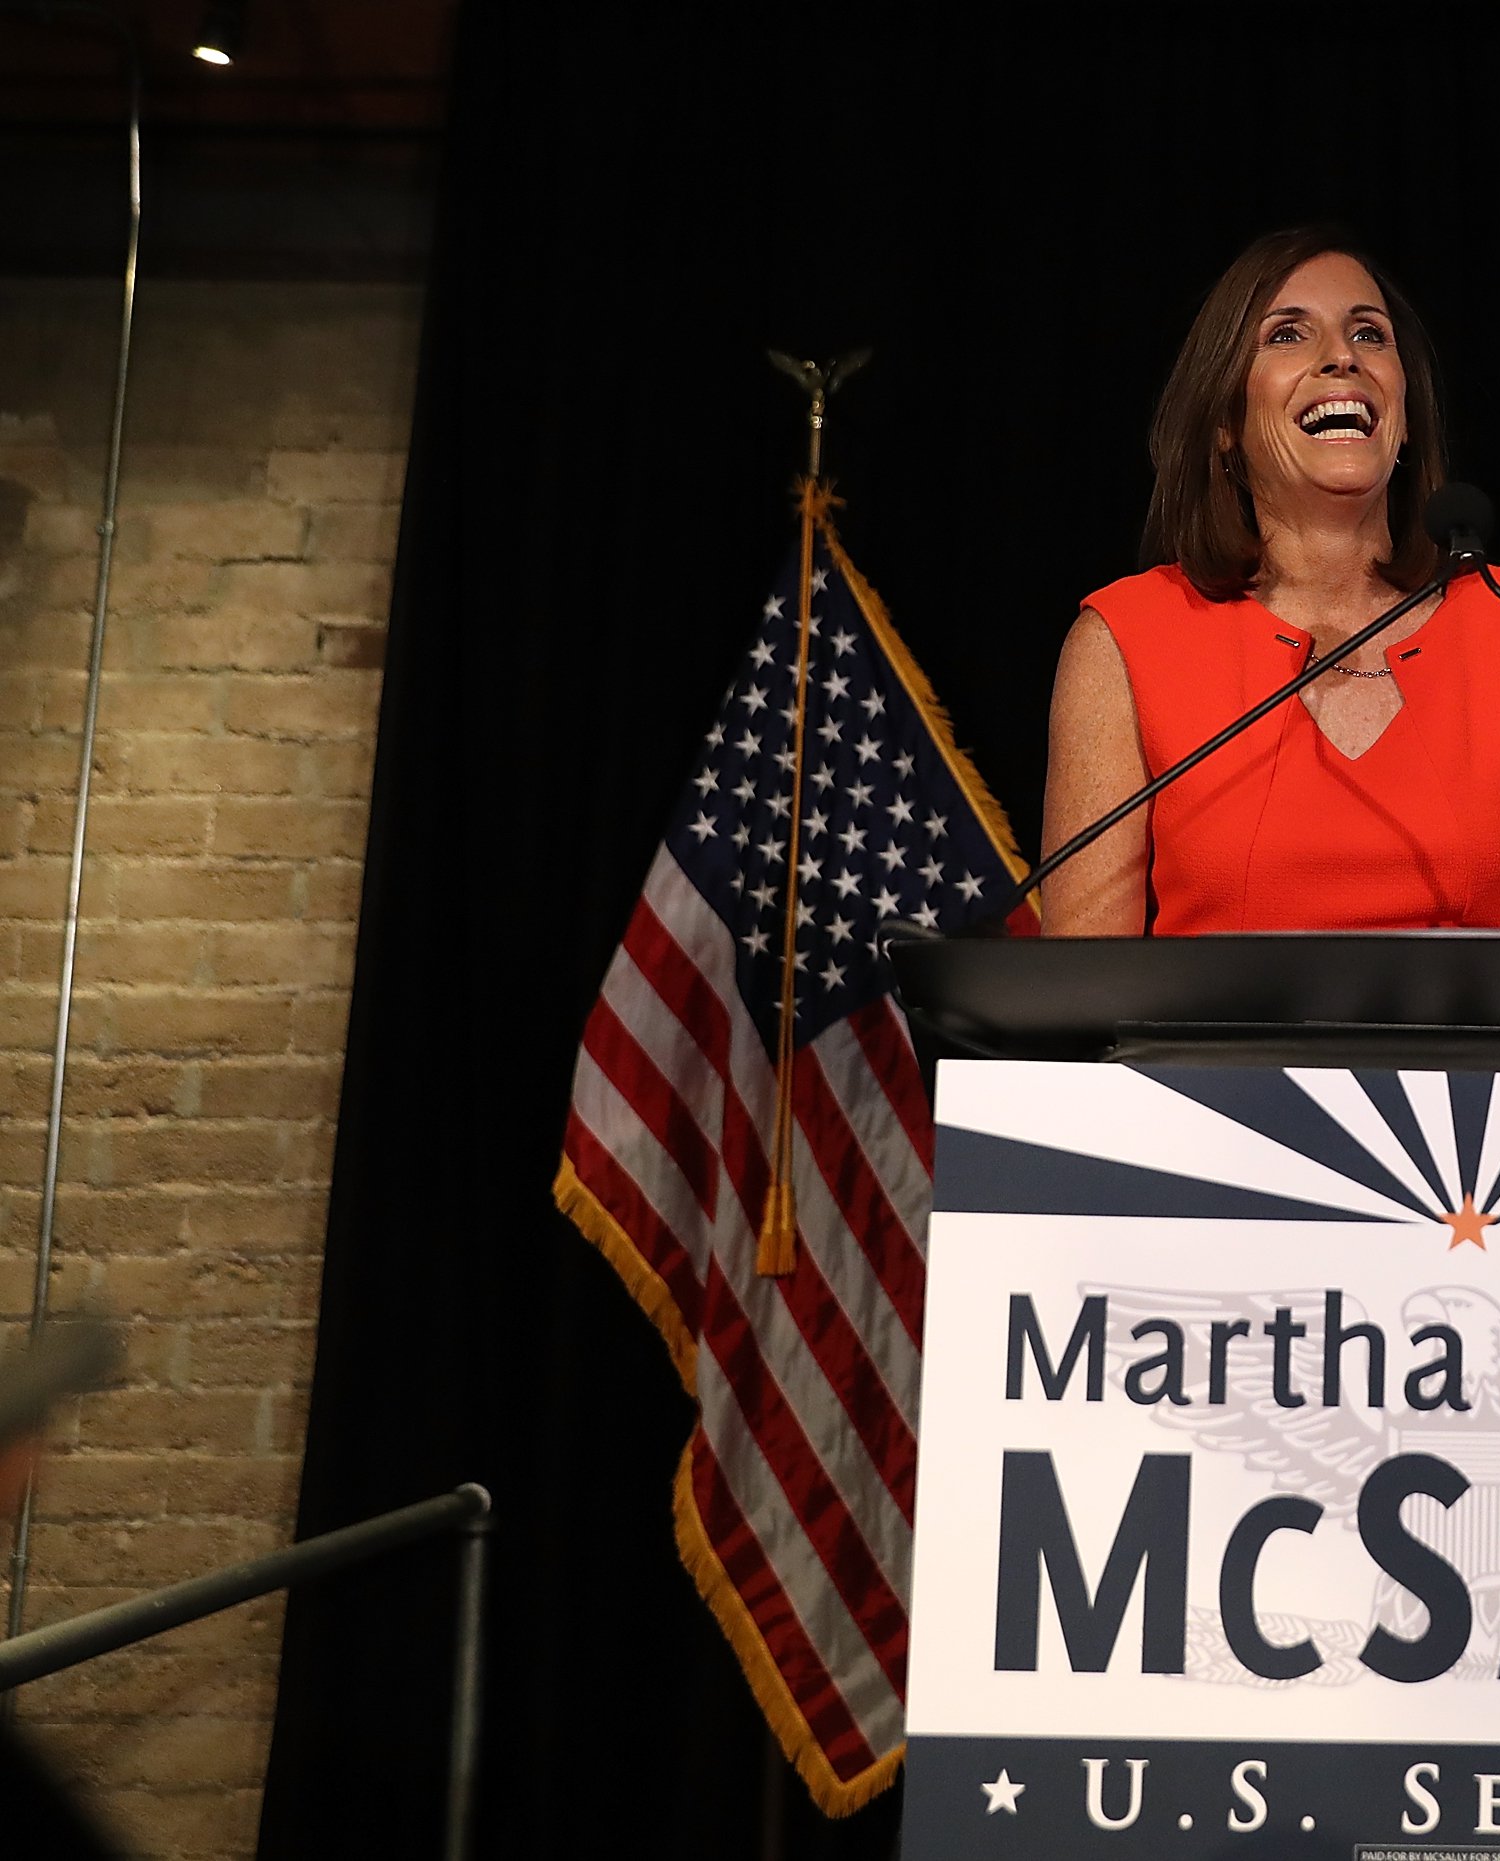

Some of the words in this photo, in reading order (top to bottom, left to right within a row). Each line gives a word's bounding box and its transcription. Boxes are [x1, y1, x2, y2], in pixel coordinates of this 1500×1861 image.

[1005, 1289, 1473, 1412] Martha
[1080, 1756, 1316, 1833] U.S.
[1361, 1850, 1385, 1861] PAID
[1386, 1850, 1408, 1861] FOR
[1408, 1851, 1421, 1861] BY
